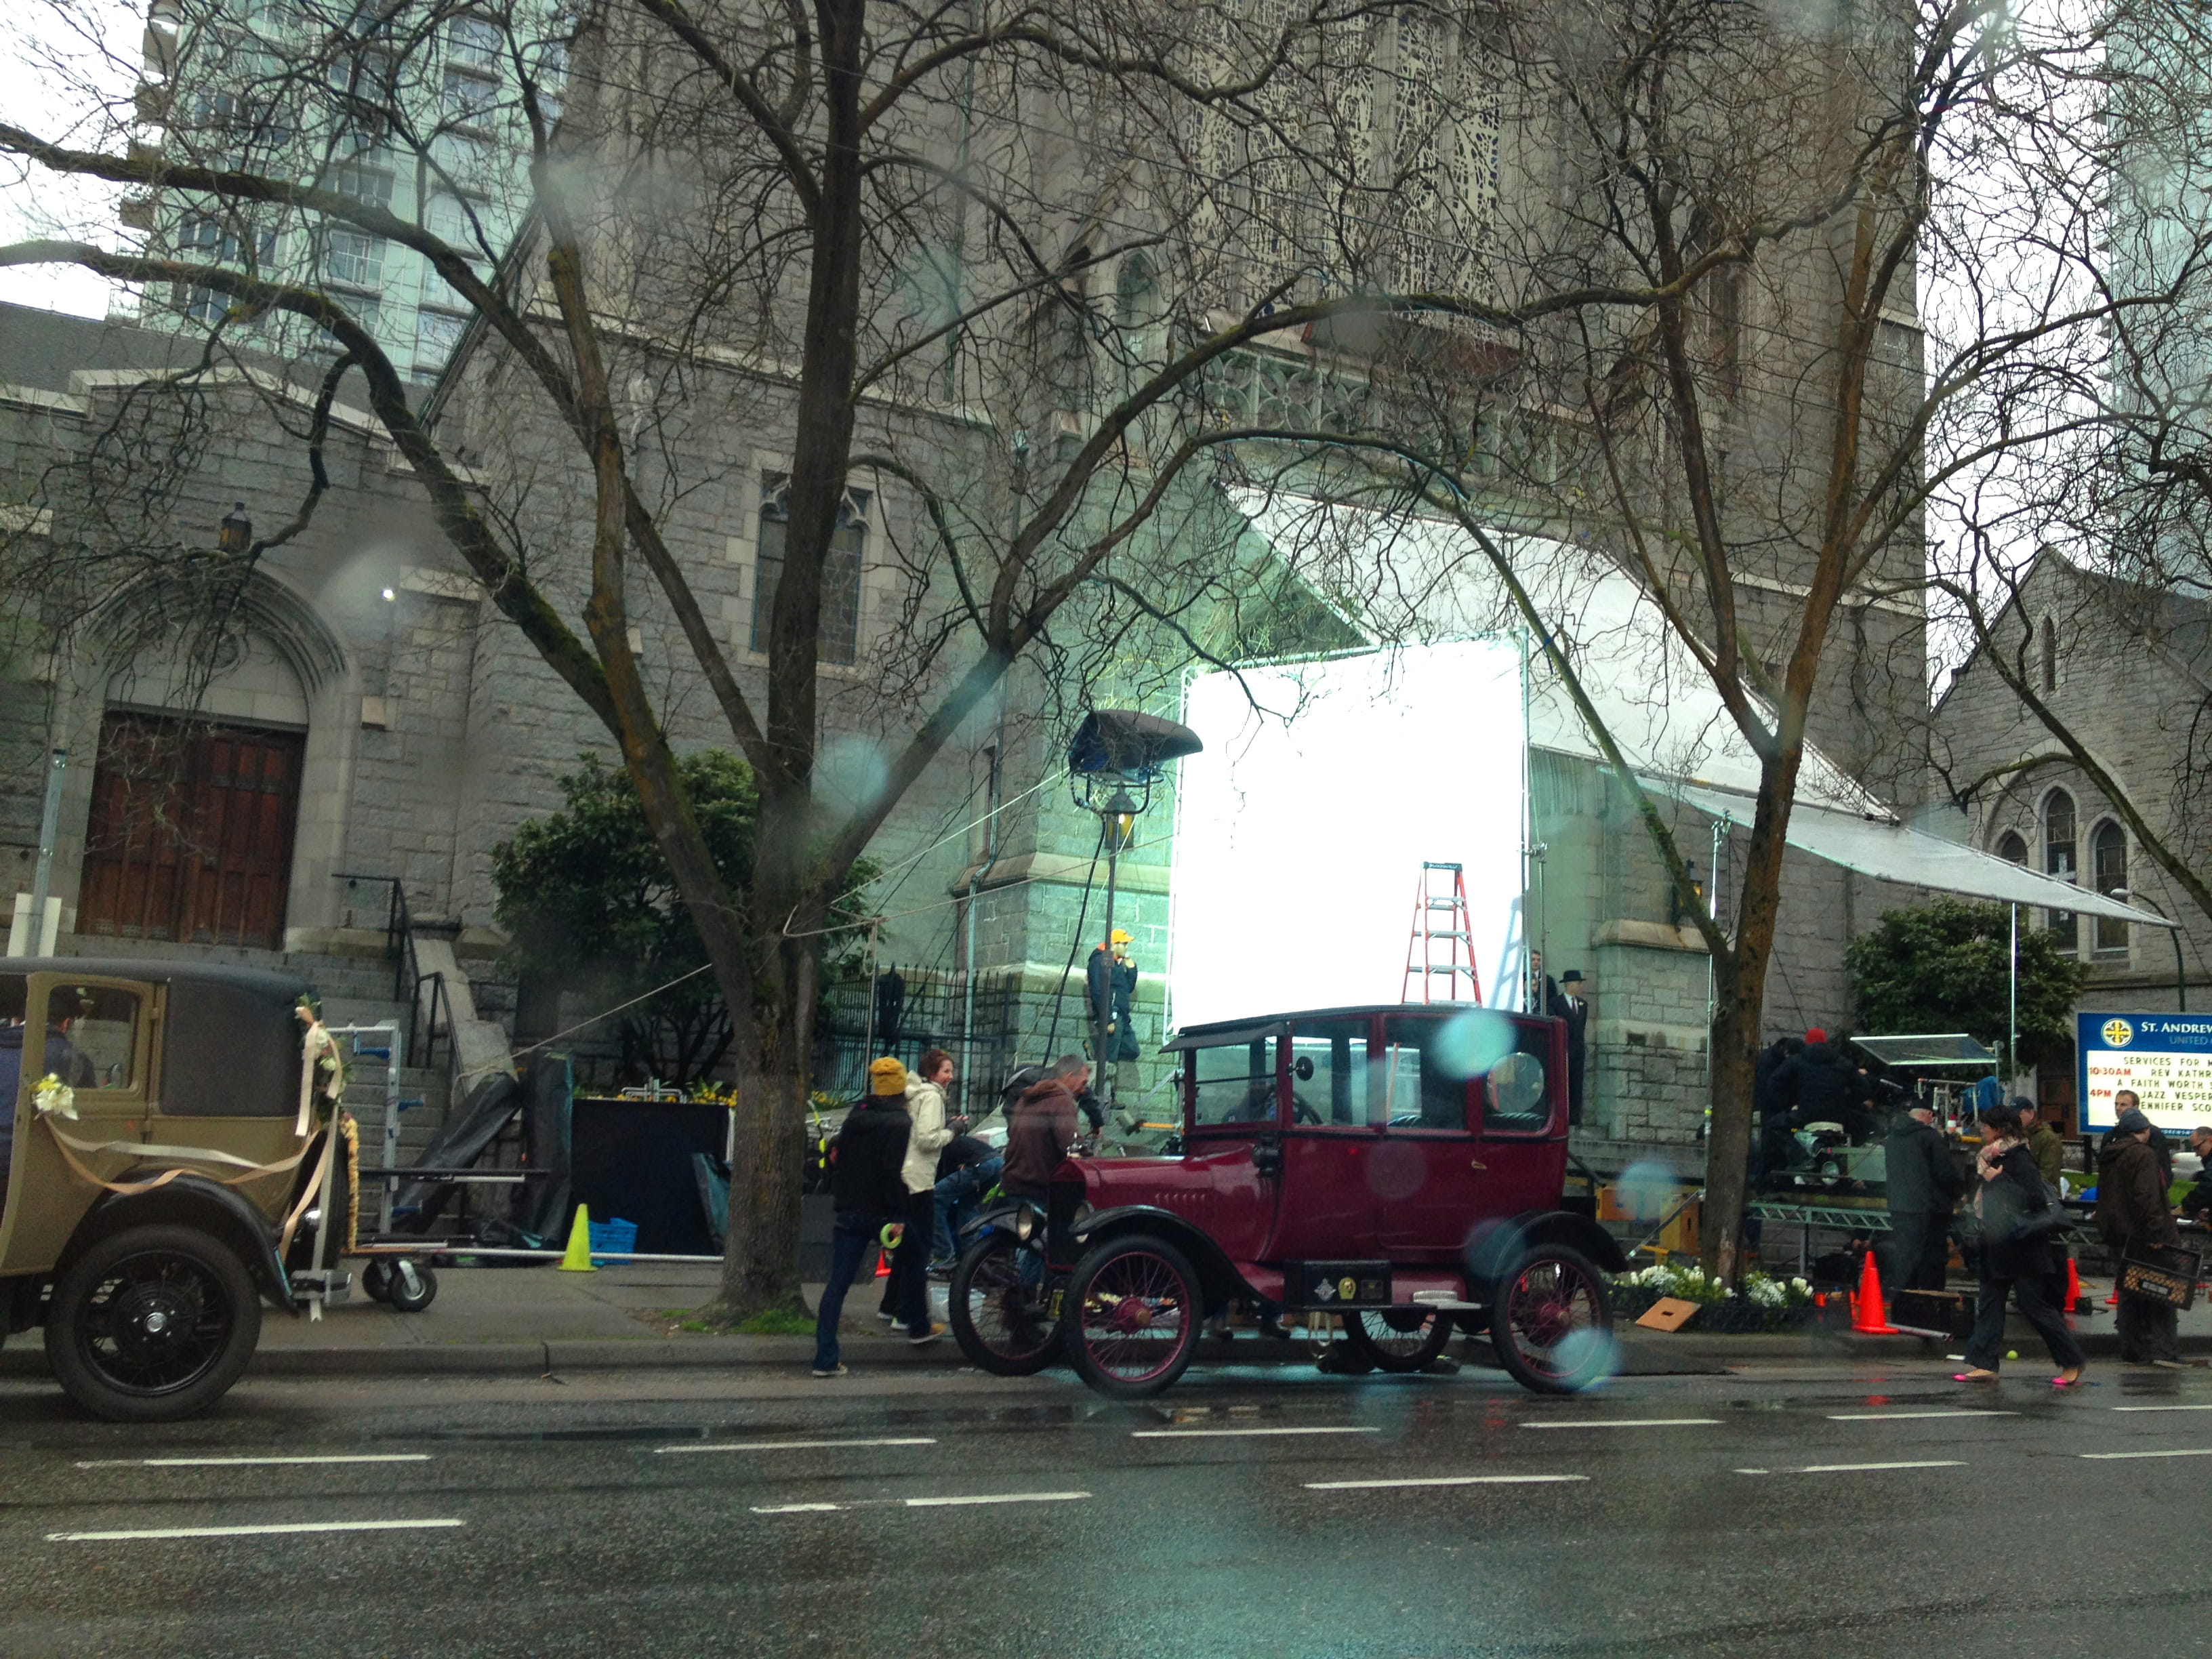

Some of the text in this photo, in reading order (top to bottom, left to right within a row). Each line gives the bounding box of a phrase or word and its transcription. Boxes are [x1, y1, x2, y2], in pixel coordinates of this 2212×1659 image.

[2141, 1021, 2158, 1032] ST.
[2169, 1036, 2209, 1045] UNITED
[2123, 1057, 2171, 1066] SERVICES
[2180, 1058, 2200, 1067] FOR
[2089, 1067, 2131, 1076] 10:30AM
[2151, 1069, 2170, 1077] REV
[2131, 1079, 2160, 1088] FAITH
[2168, 1080, 2203, 1089] WORTH
[2090, 1089, 2212, 1101] 4PM JAZZ VESPER
[2141, 1101, 2184, 1111] ENNIFER
